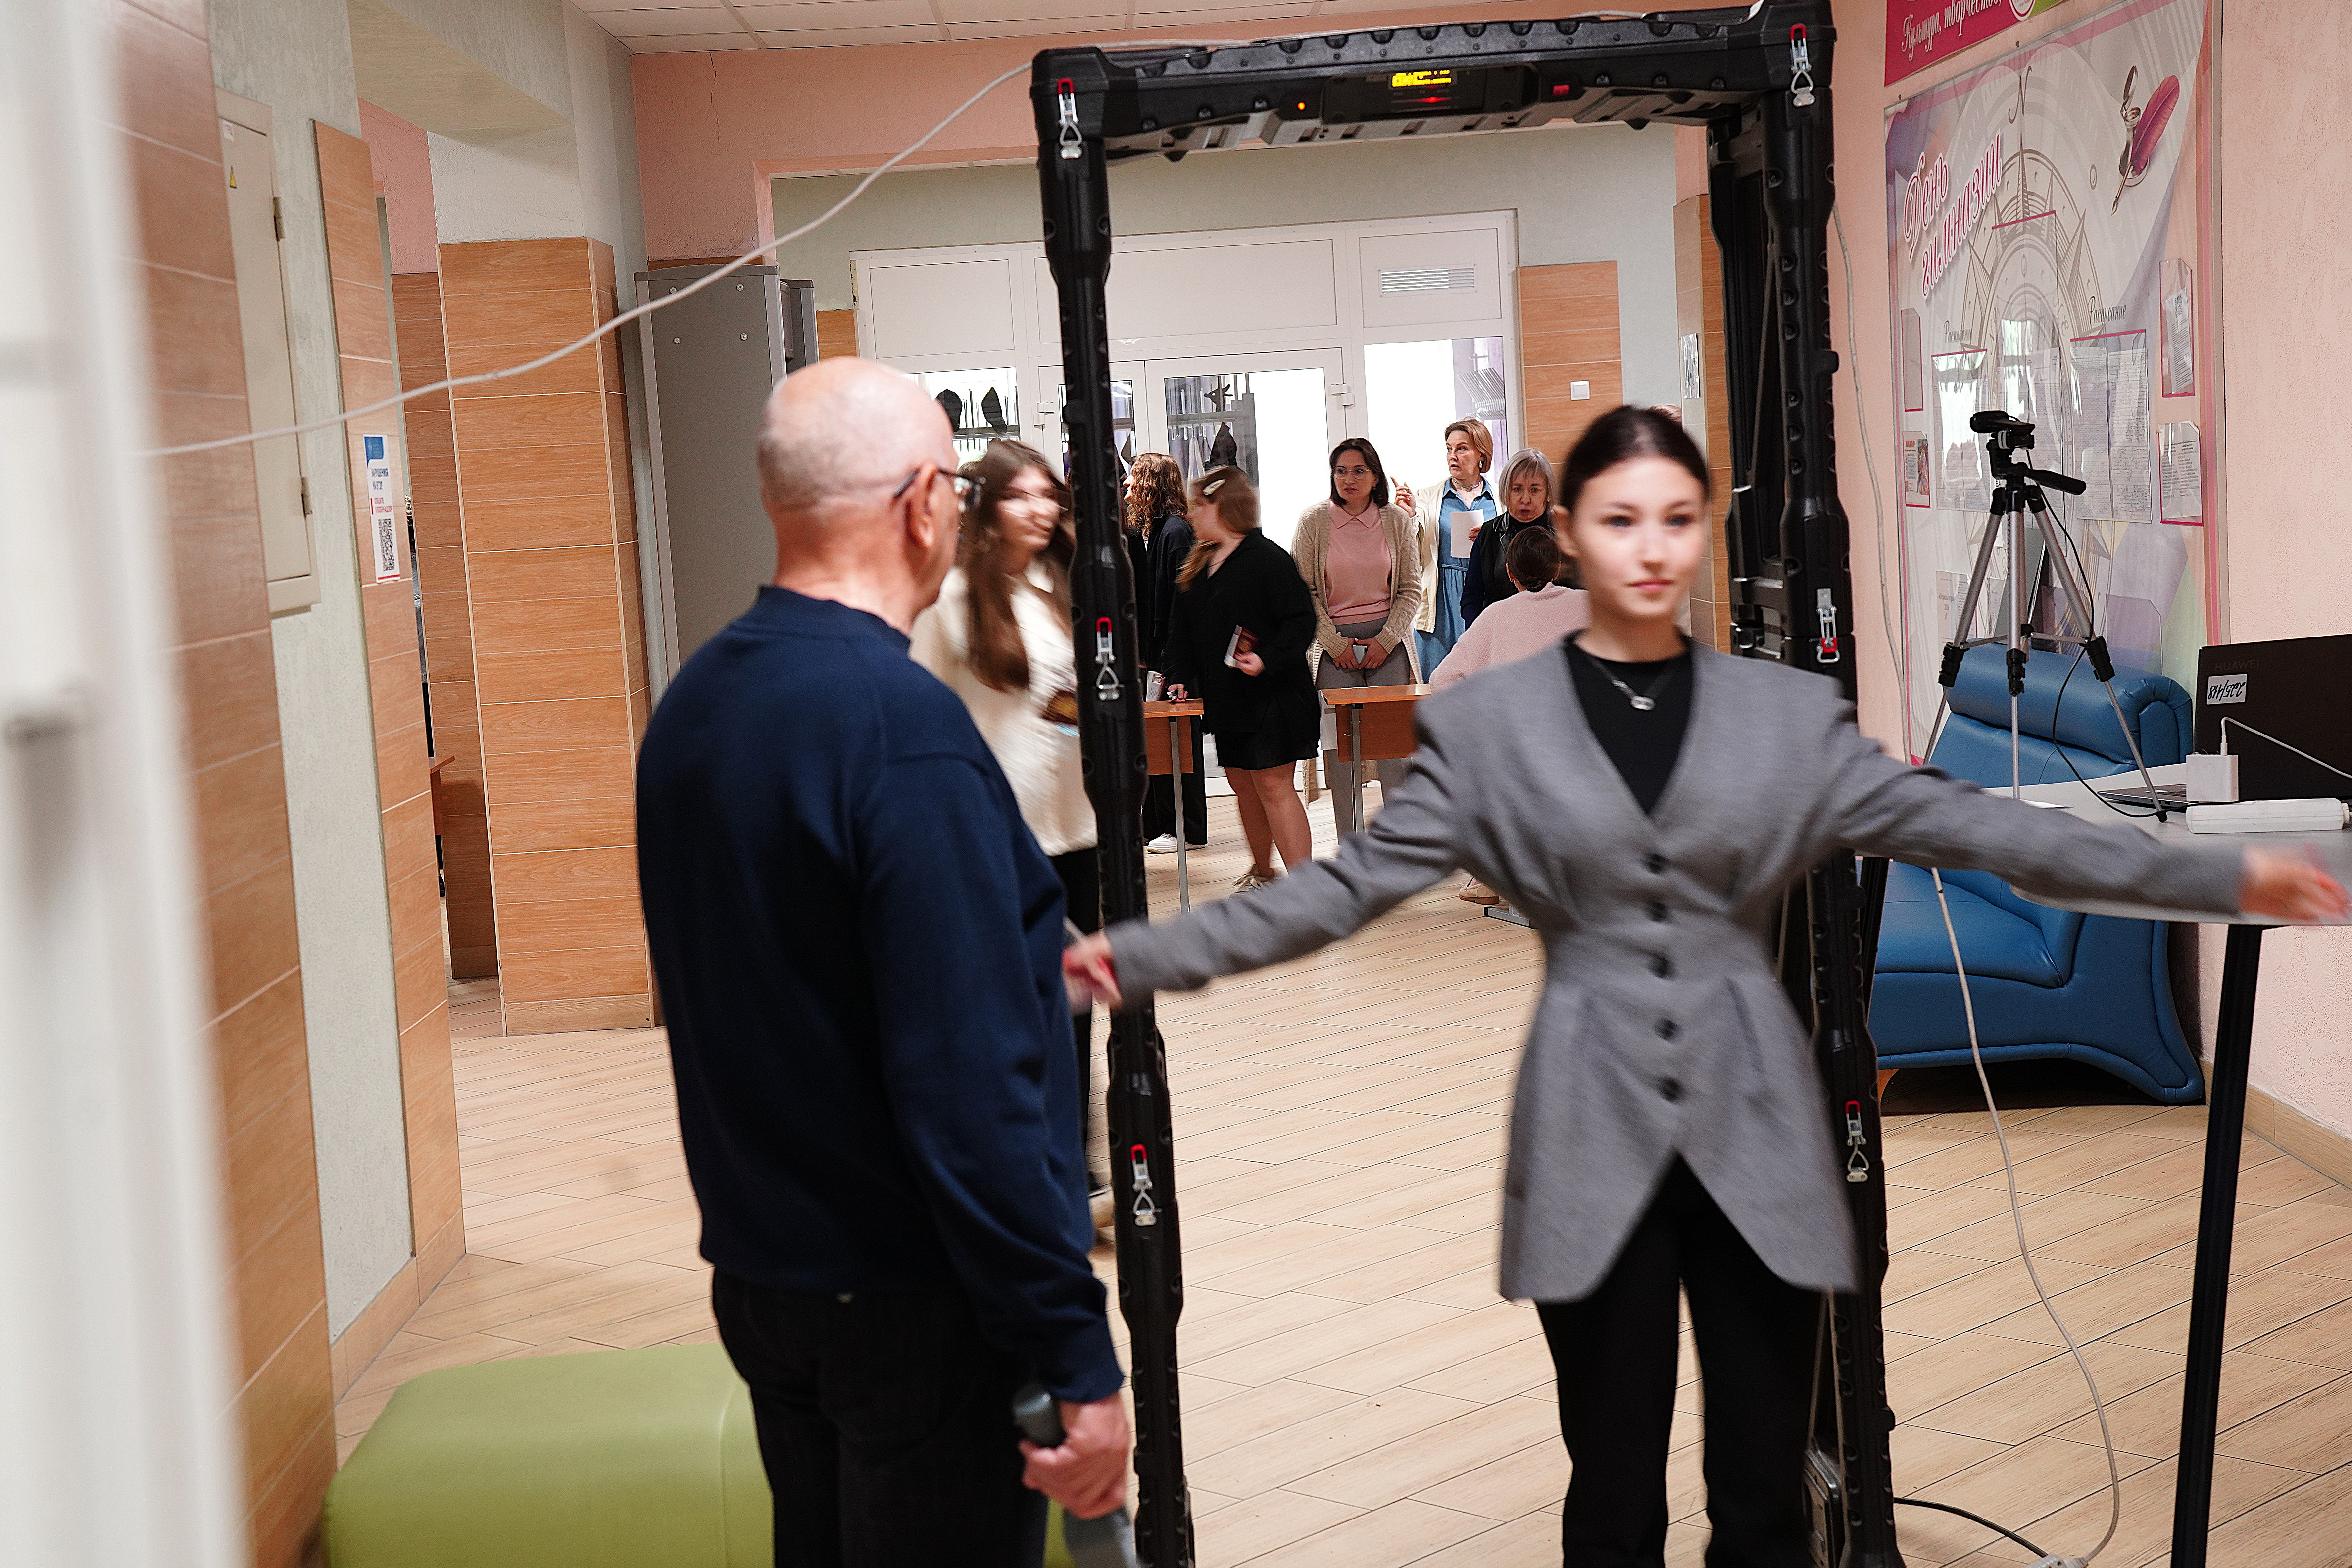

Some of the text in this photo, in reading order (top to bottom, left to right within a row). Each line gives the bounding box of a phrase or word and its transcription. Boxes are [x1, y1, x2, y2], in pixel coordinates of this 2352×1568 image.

[1902, 0, 2002, 61] Культура, творчес,
[1903, 151, 1949, 263] День
[1921, 131, 2003, 299] гимназии
[2087, 296, 2126, 324] Расписание
[2215, 659, 2259, 671] HUAWEI
